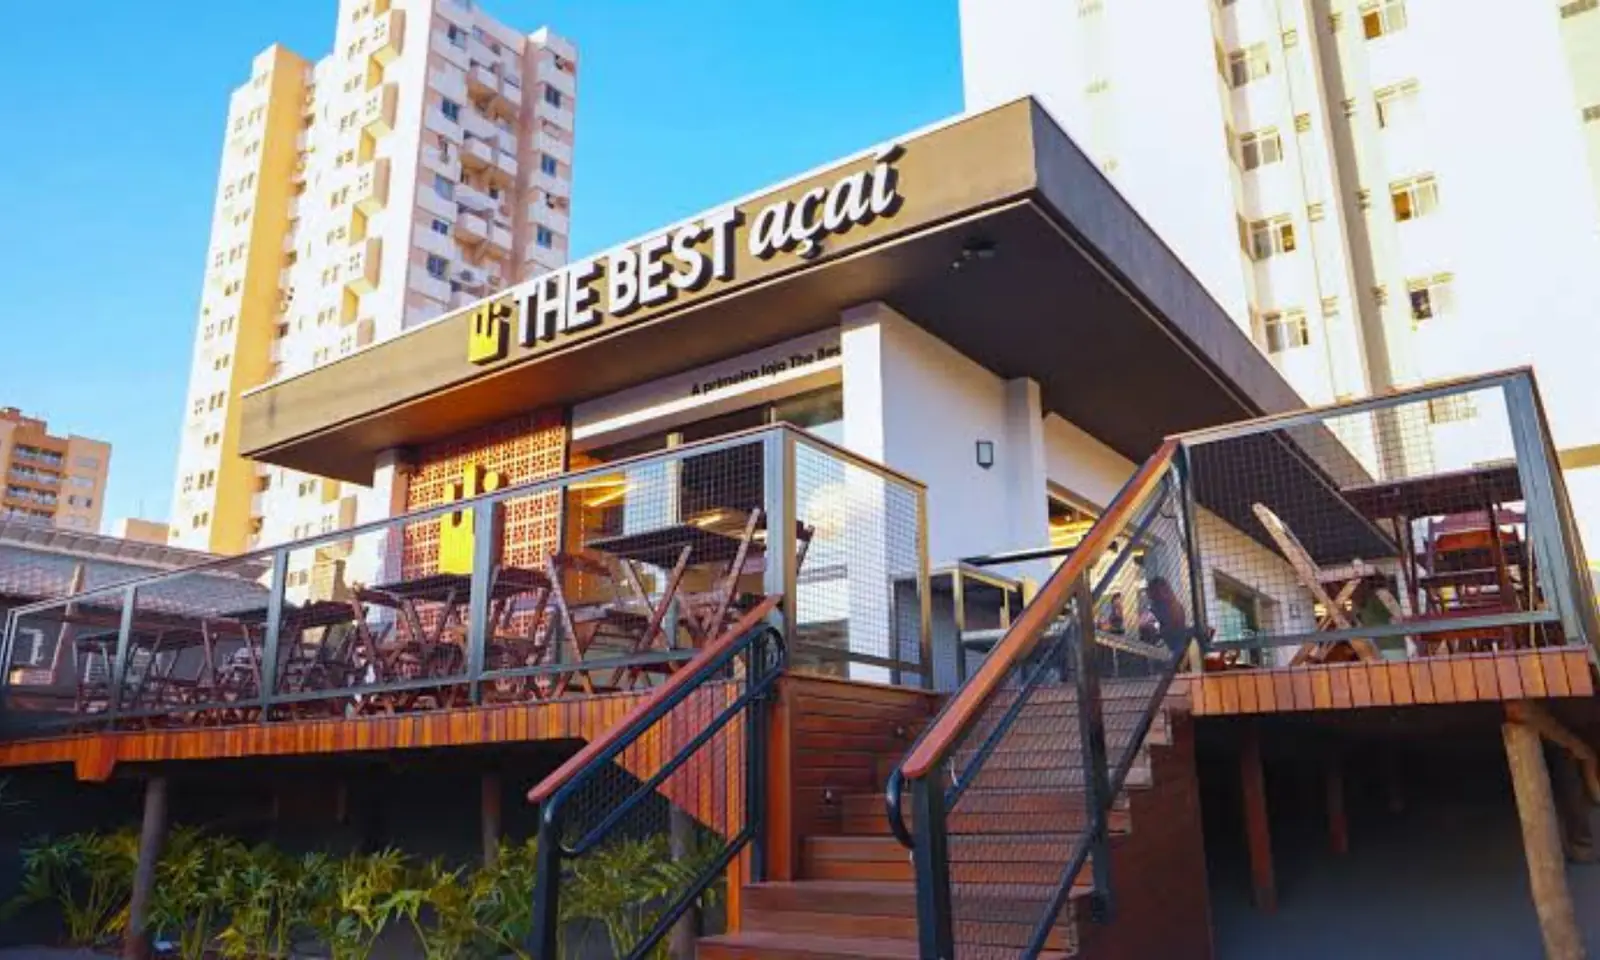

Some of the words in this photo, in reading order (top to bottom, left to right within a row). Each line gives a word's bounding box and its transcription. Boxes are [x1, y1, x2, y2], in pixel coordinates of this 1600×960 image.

[514, 263, 597, 343] THE
[607, 206, 738, 314] BEST
[748, 142, 898, 257] açaí
[691, 383, 701, 395] A
[703, 369, 758, 393] primeira
[761, 360, 787, 379] loja
[790, 353, 814, 368] The
[817, 345, 841, 361] Bes
